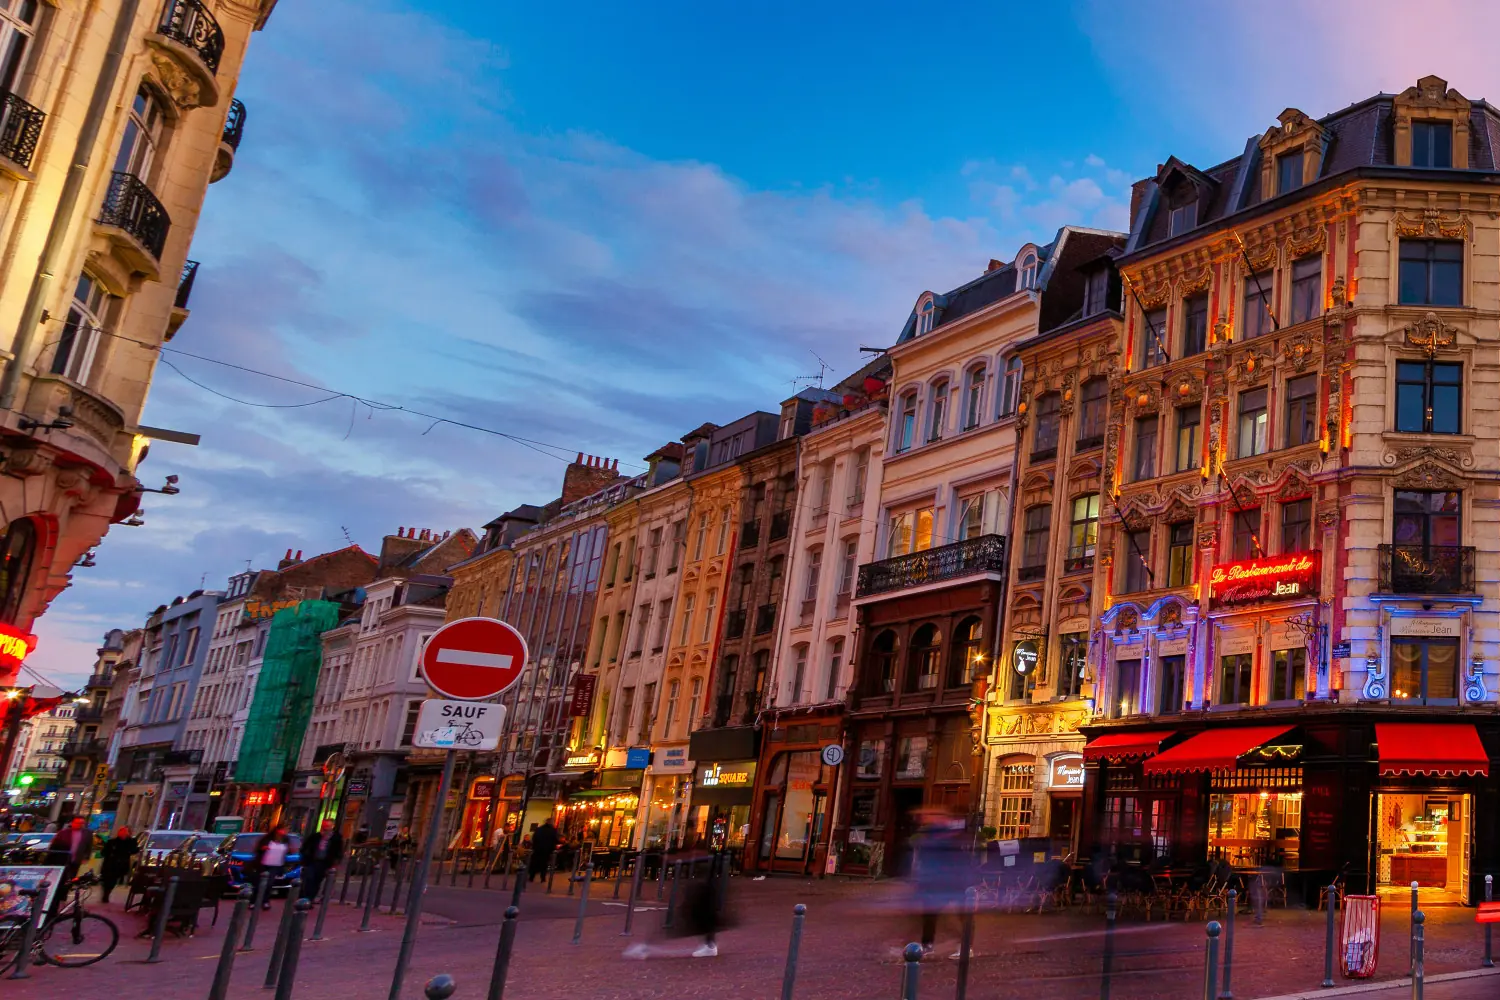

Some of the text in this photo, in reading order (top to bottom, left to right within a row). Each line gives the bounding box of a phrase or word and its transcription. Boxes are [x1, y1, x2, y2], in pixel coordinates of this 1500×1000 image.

[1272, 580, 1299, 596] Jean
[1431, 624, 1452, 634] Jean
[441, 704, 488, 719] SAUF
[719, 772, 748, 785] SQUARE
[1066, 775, 1080, 784] Jean
